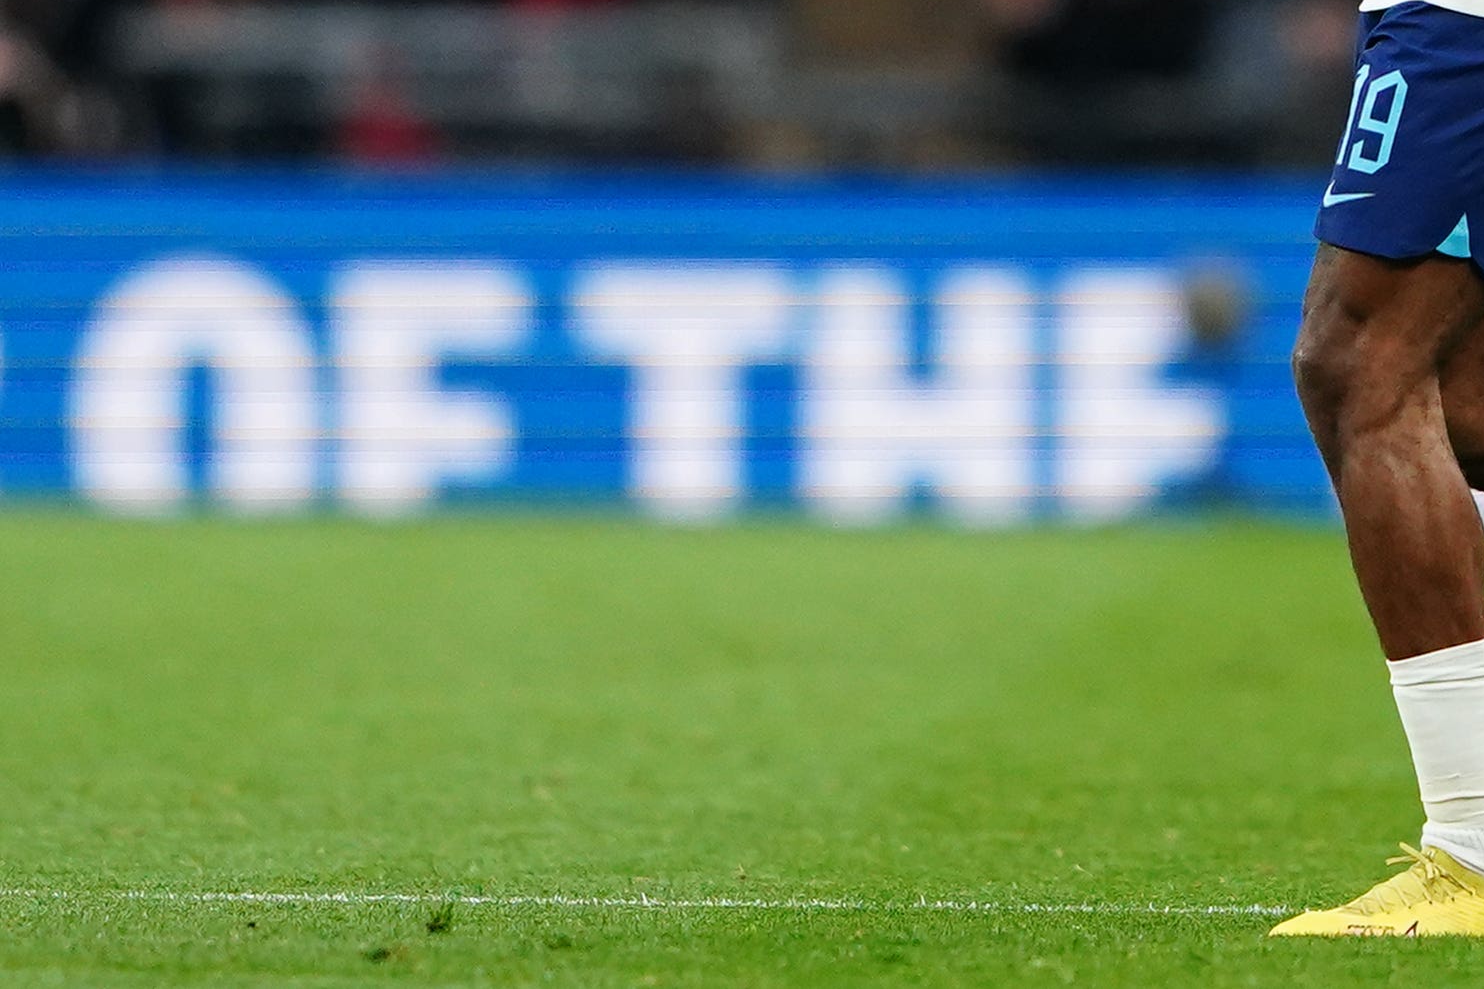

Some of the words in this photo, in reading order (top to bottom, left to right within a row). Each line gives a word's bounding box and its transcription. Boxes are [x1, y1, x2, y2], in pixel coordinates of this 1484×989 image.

[1336, 63, 1409, 175] 19
[68, 257, 532, 520] OF
[572, 264, 1226, 528] THE
